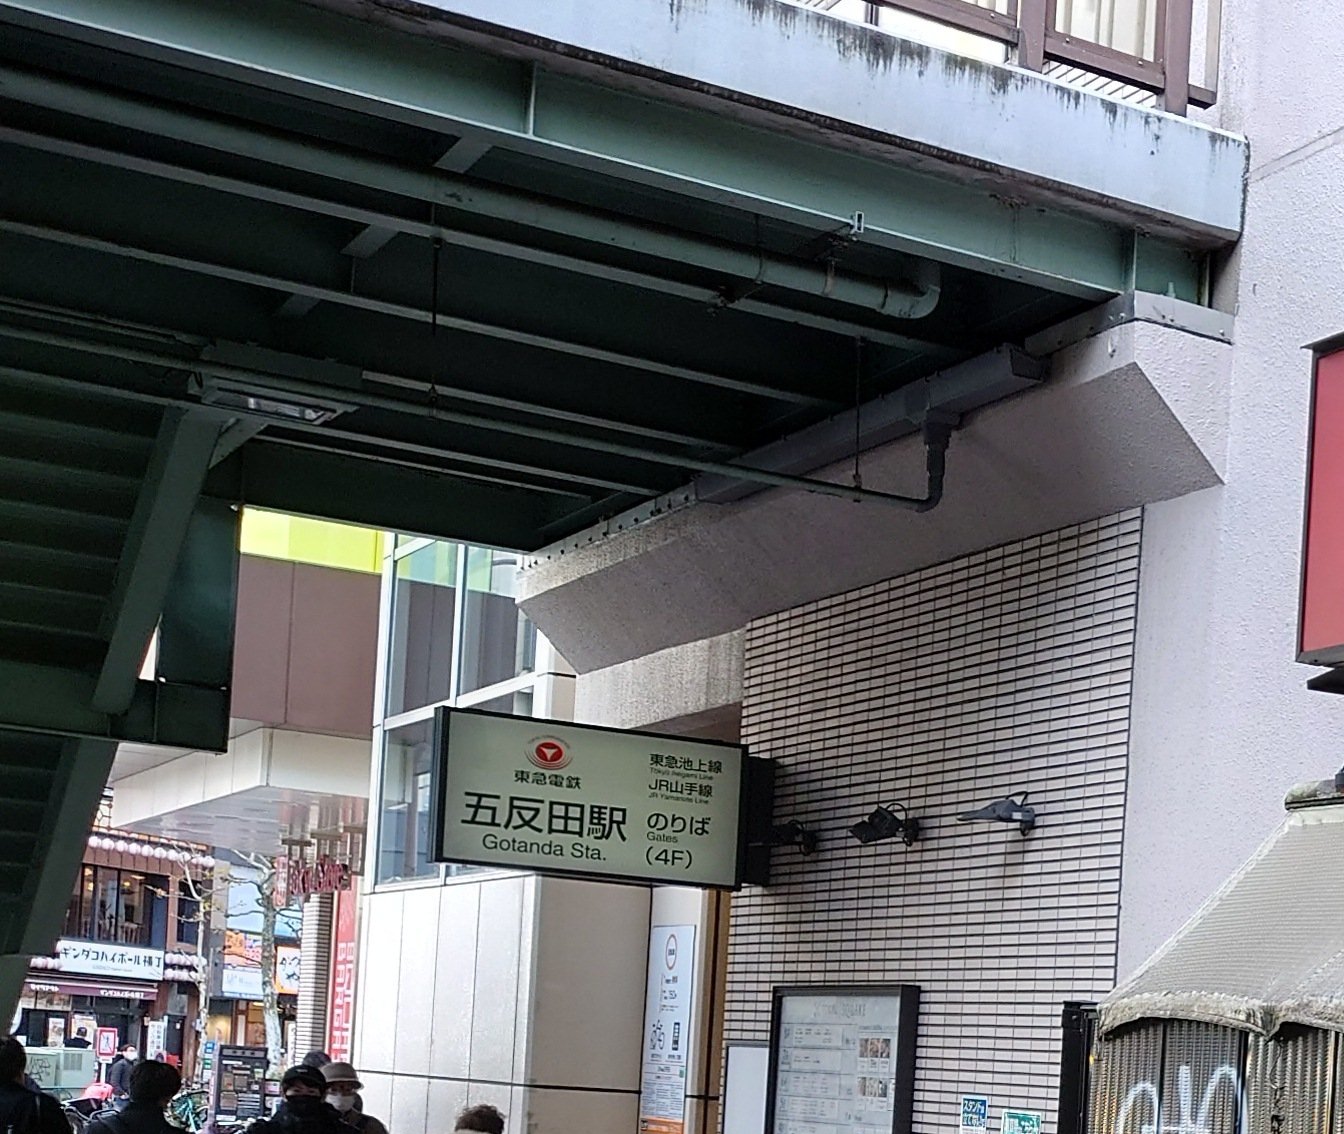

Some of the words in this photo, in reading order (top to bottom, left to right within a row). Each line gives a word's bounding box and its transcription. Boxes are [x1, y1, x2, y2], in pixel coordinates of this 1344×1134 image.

[649, 754, 722, 773] 東急池上線
[514, 769, 581, 789] 東急電鉄
[649, 779, 712, 797] JR山手線
[461, 791, 627, 842] 五反田駅
[647, 812, 711, 836] のりば
[482, 834, 564, 857] Gotanda
[570, 844, 606, 861] Sta.
[647, 831, 678, 843] Gates
[646, 847, 693, 869] (4F)
